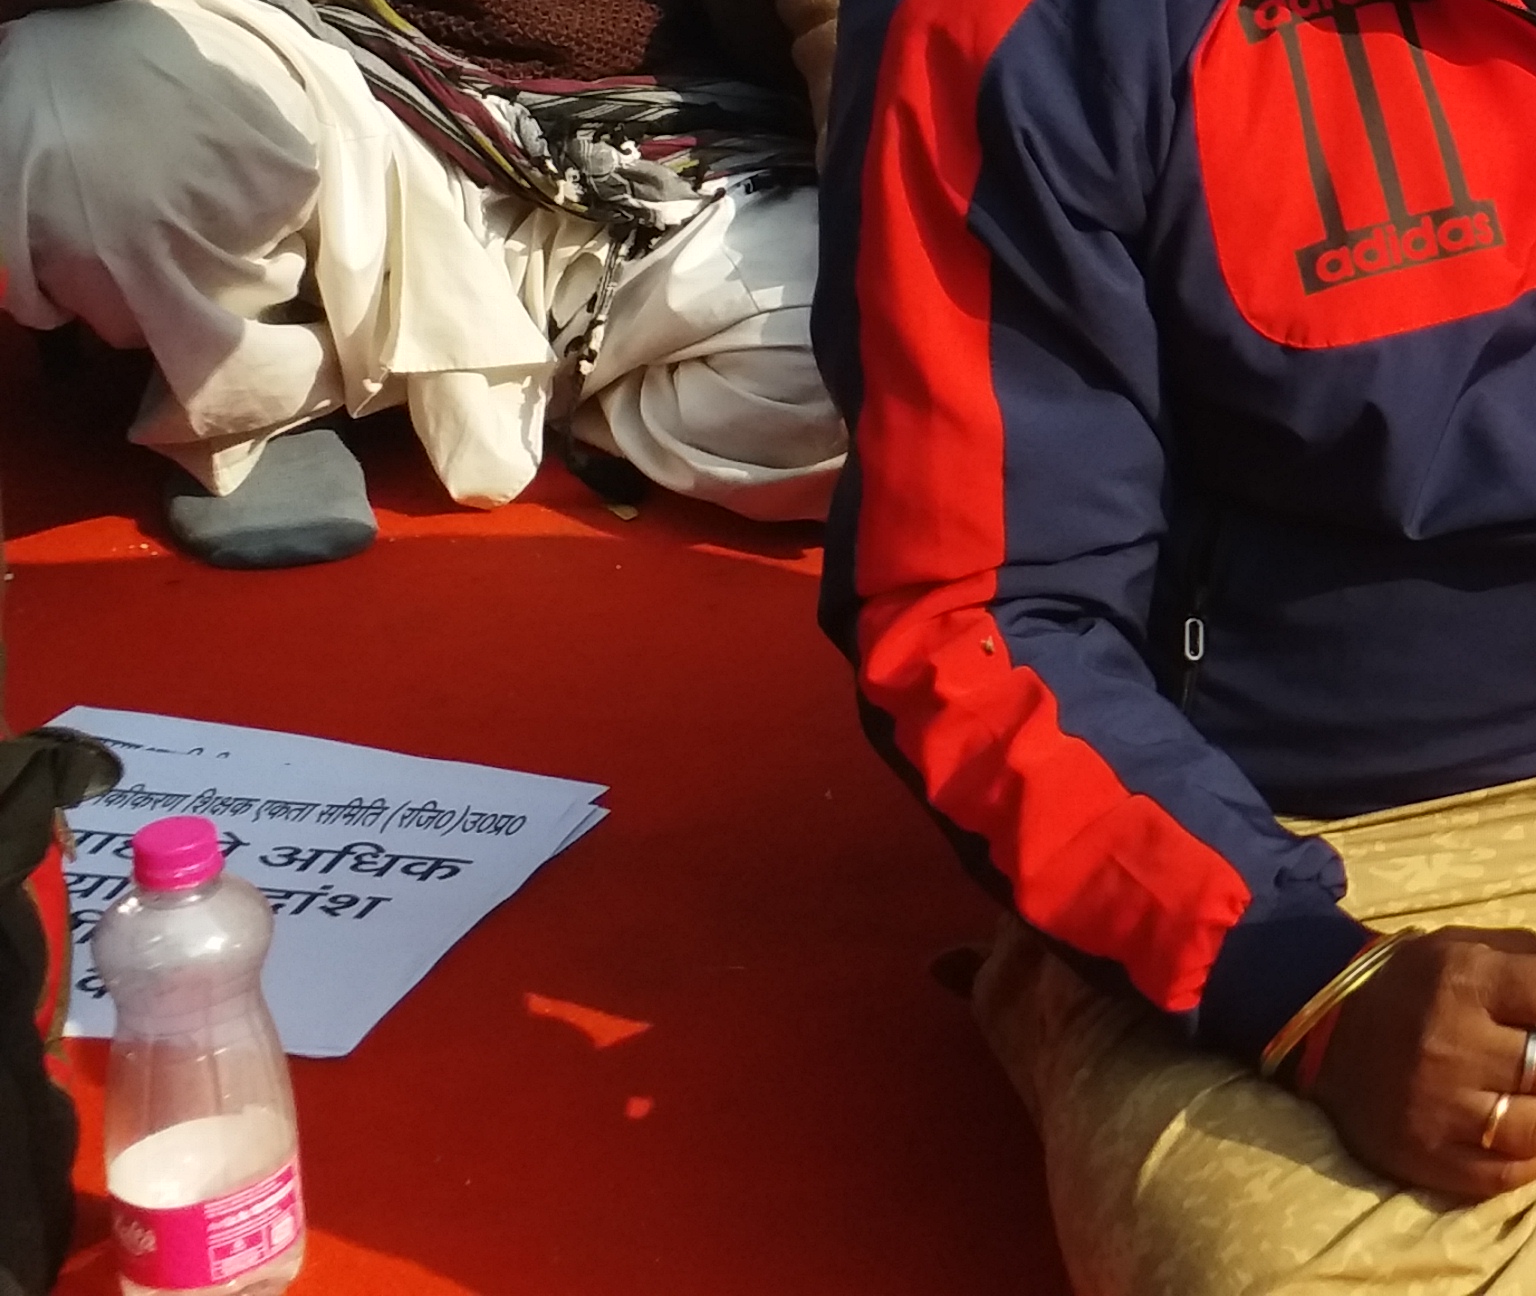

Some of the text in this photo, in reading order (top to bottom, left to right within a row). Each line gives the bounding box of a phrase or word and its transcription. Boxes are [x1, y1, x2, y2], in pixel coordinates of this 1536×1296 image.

[1314, 211, 1494, 285] adidas
[186, 788, 389, 825] शिक्षक एकता समिति
[258, 841, 473, 883] अधिक
